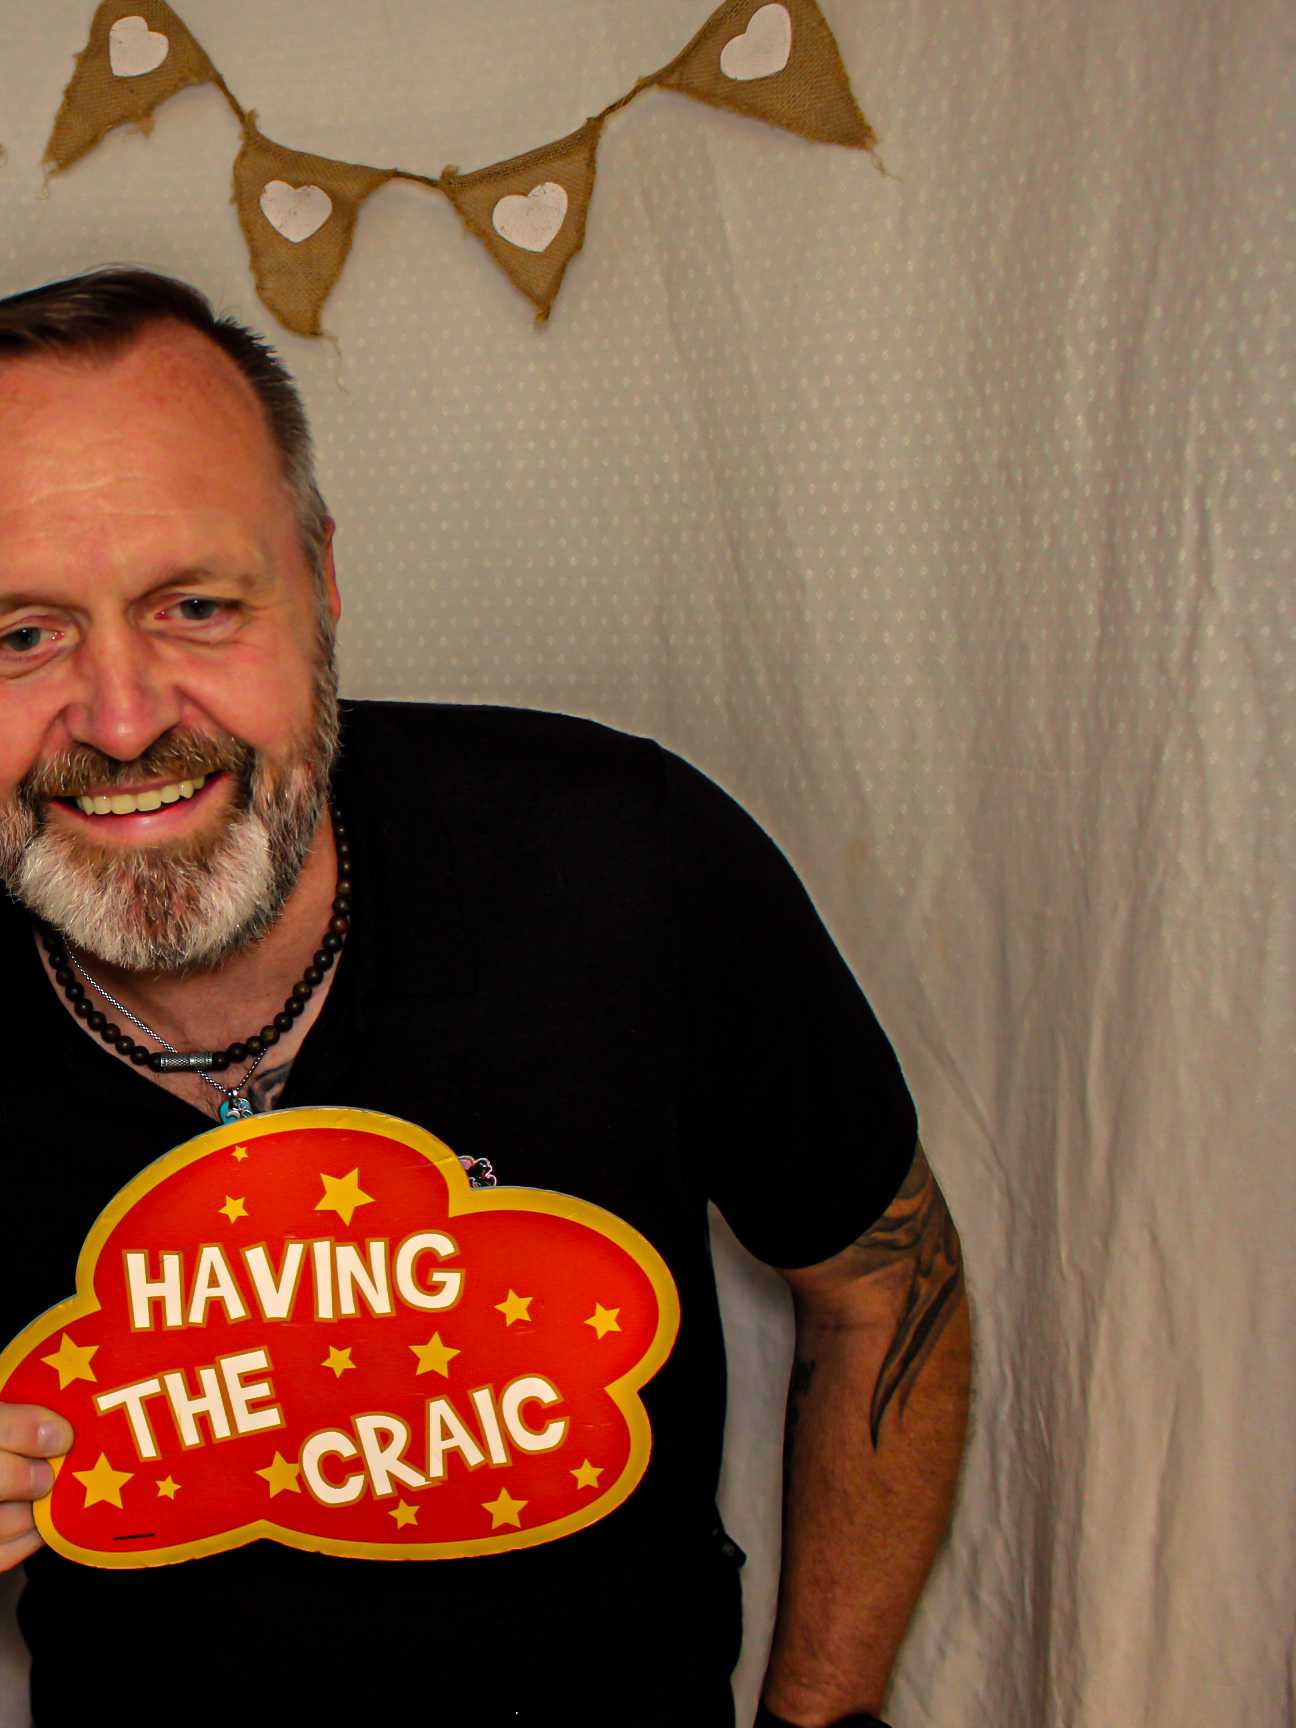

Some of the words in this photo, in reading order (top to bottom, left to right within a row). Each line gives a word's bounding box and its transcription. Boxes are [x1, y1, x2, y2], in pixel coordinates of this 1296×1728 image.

[125, 1232, 462, 1330] HAVING
[95, 1349, 282, 1459] THE
[302, 1376, 566, 1504] CRAIC
